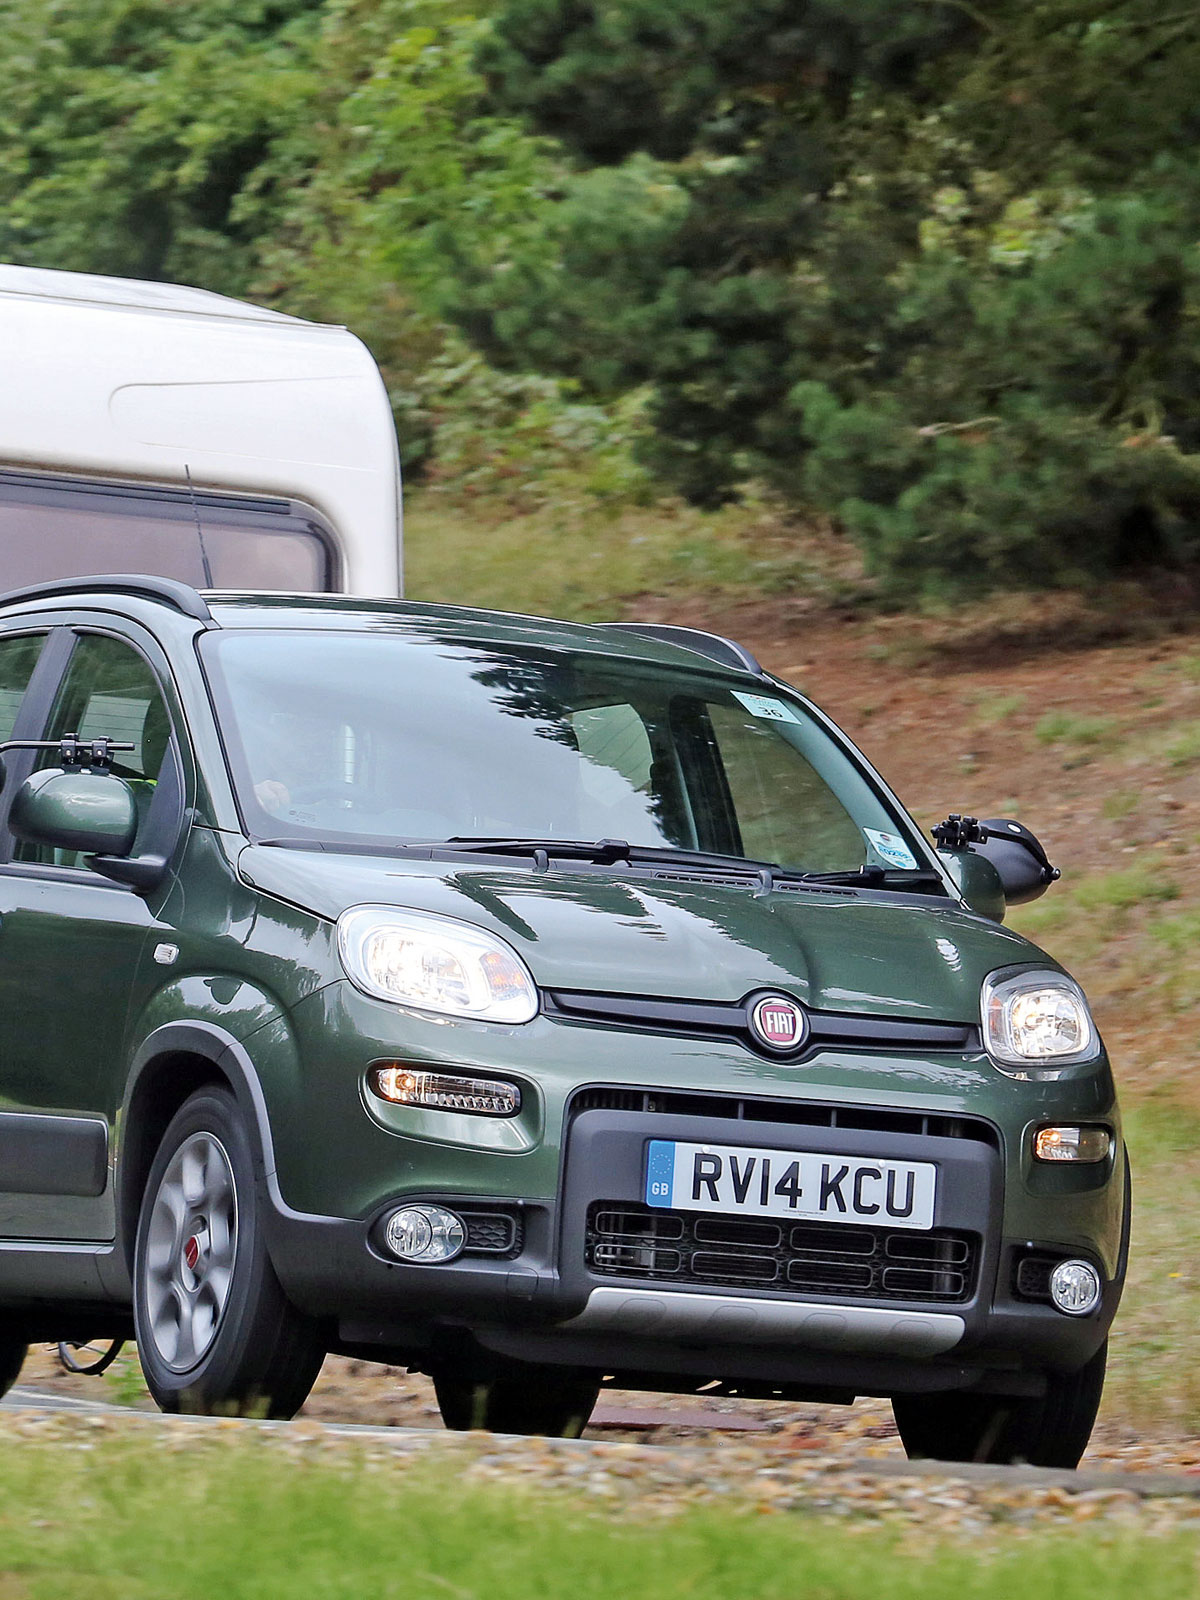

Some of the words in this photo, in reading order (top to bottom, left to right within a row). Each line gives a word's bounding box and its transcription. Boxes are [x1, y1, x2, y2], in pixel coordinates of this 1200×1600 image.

[758, 706, 784, 718] 36
[766, 1011, 794, 1035] FIAT
[651, 1182, 669, 1196] GB
[692, 1152, 803, 1208] RV14
[819, 1163, 915, 1218] KCU
